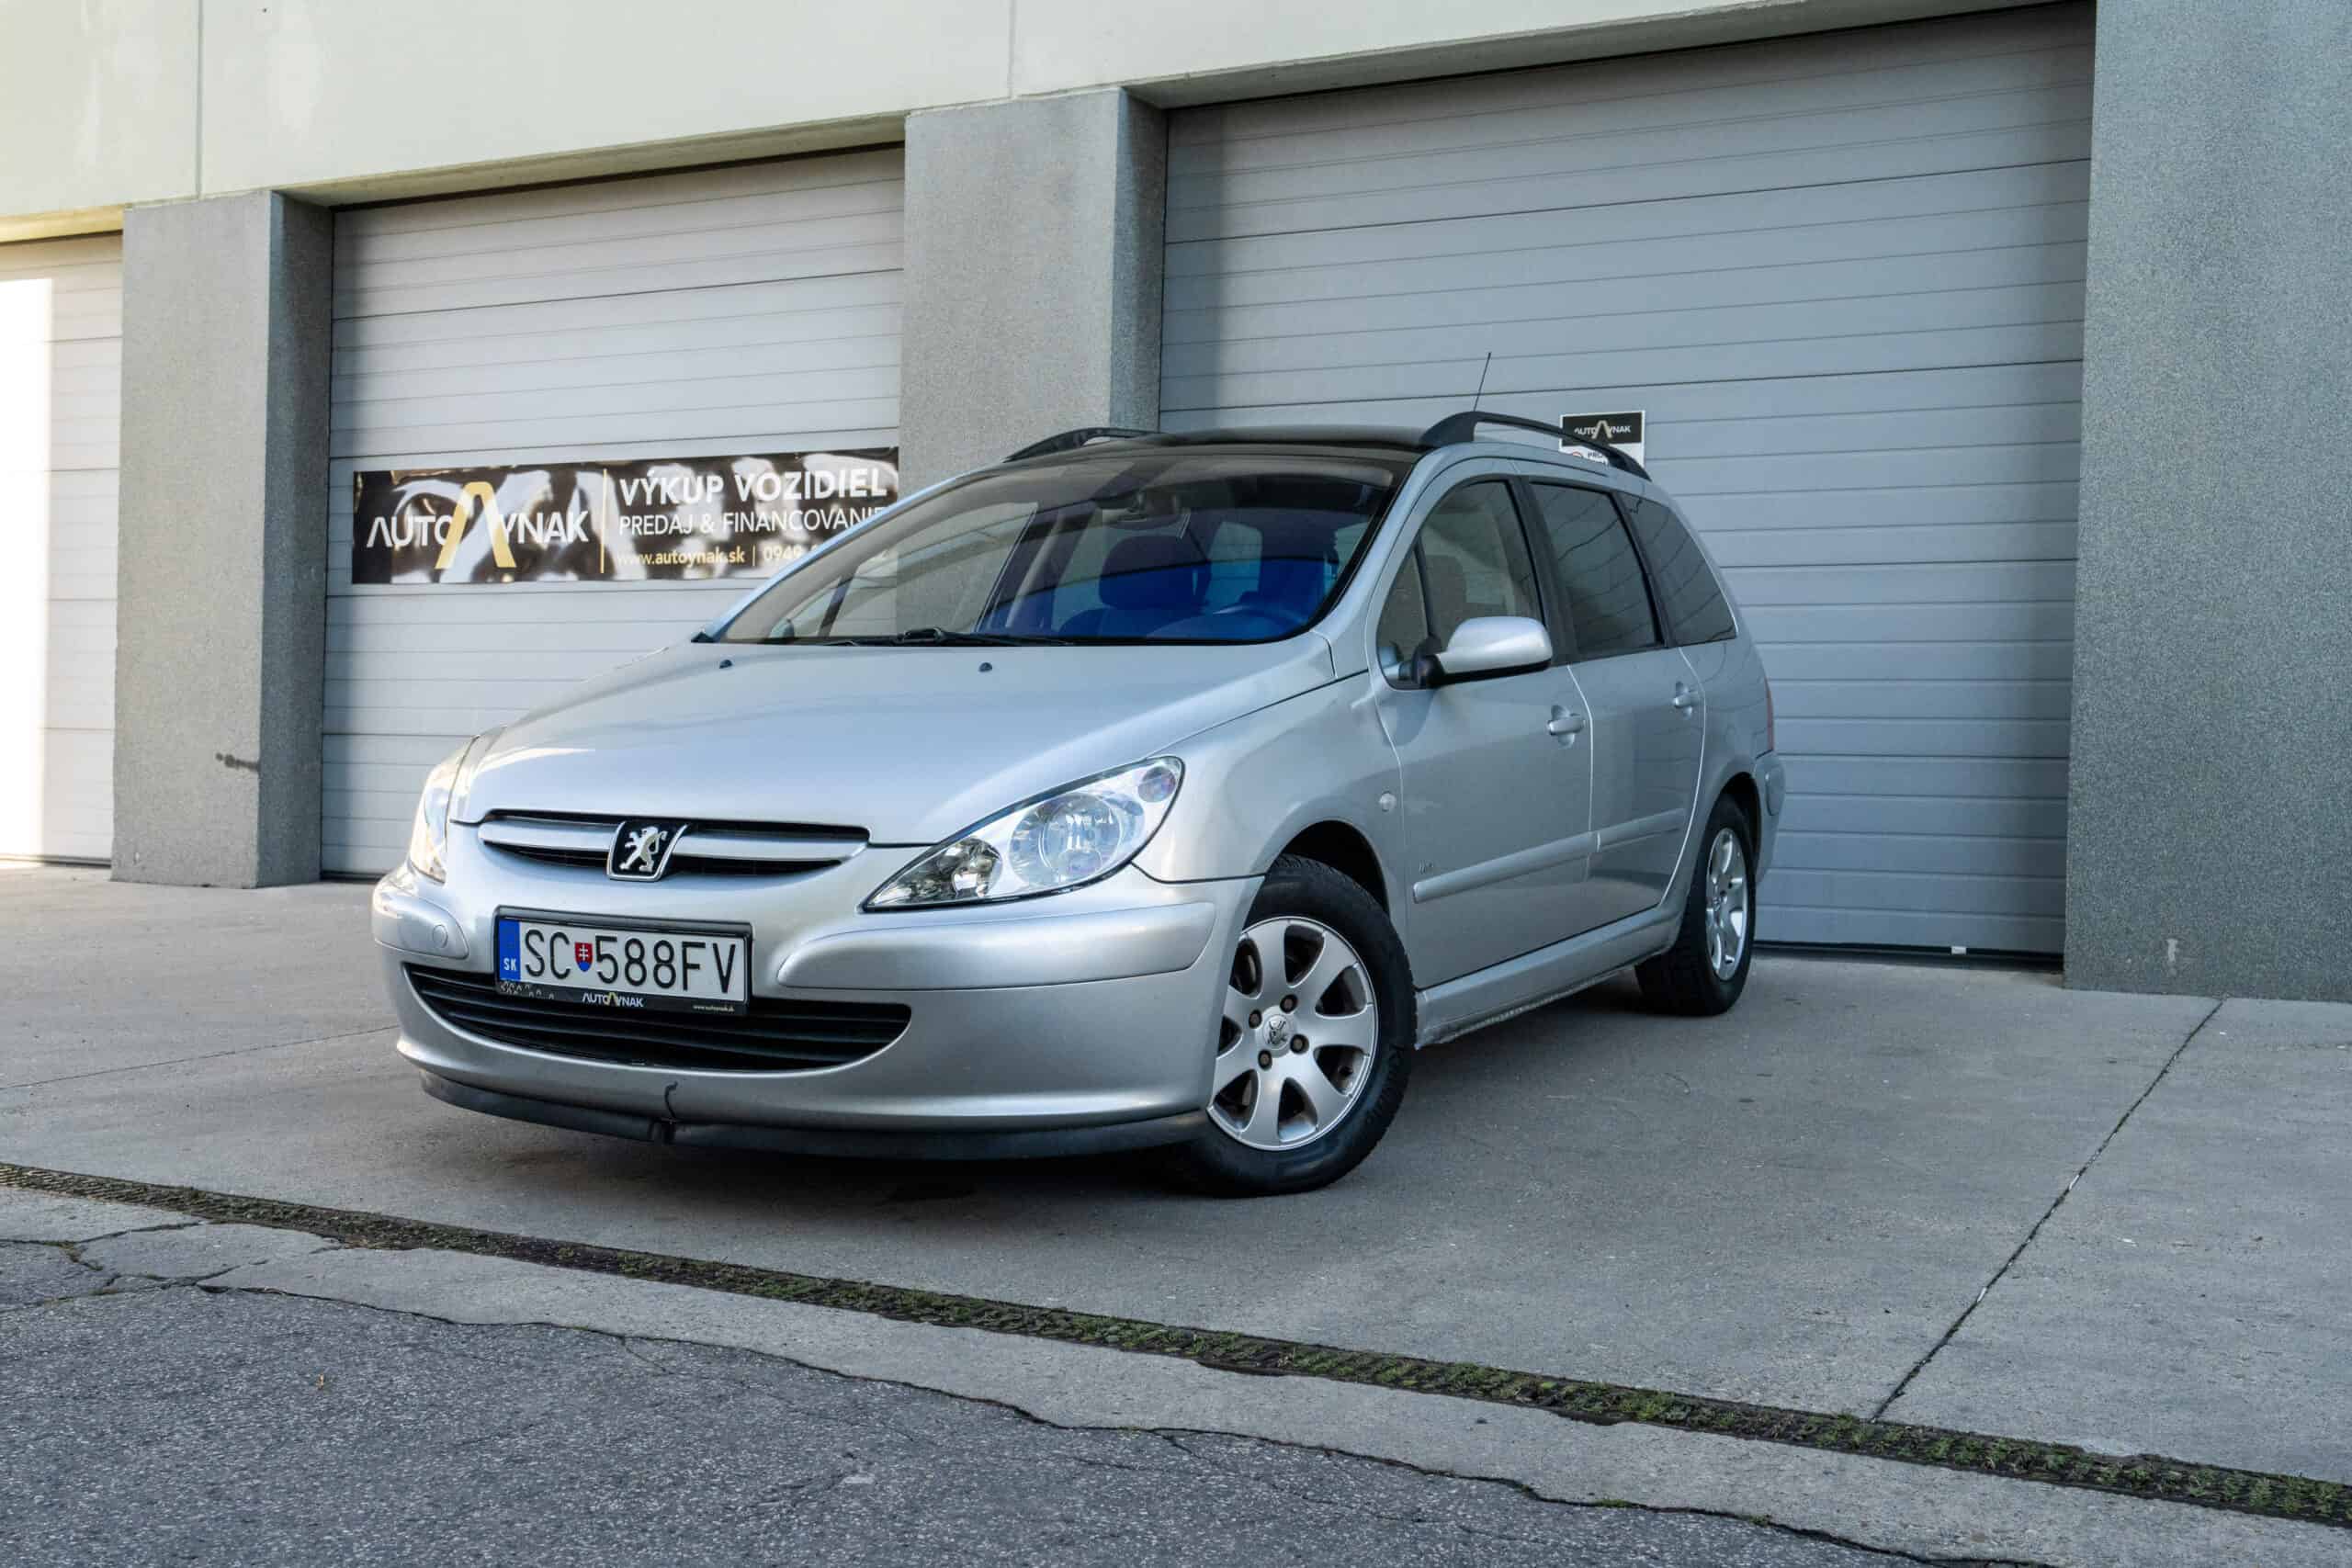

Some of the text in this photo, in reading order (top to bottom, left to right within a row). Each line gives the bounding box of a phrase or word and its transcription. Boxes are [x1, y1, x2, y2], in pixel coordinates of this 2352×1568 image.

[618, 468, 888, 506] VÝKUP VOZIDIEL
[618, 513, 693, 536] PREDAJ
[699, 513, 716, 534] &
[616, 545, 746, 568] www.autoynak.sk
[503, 957, 517, 971] SK
